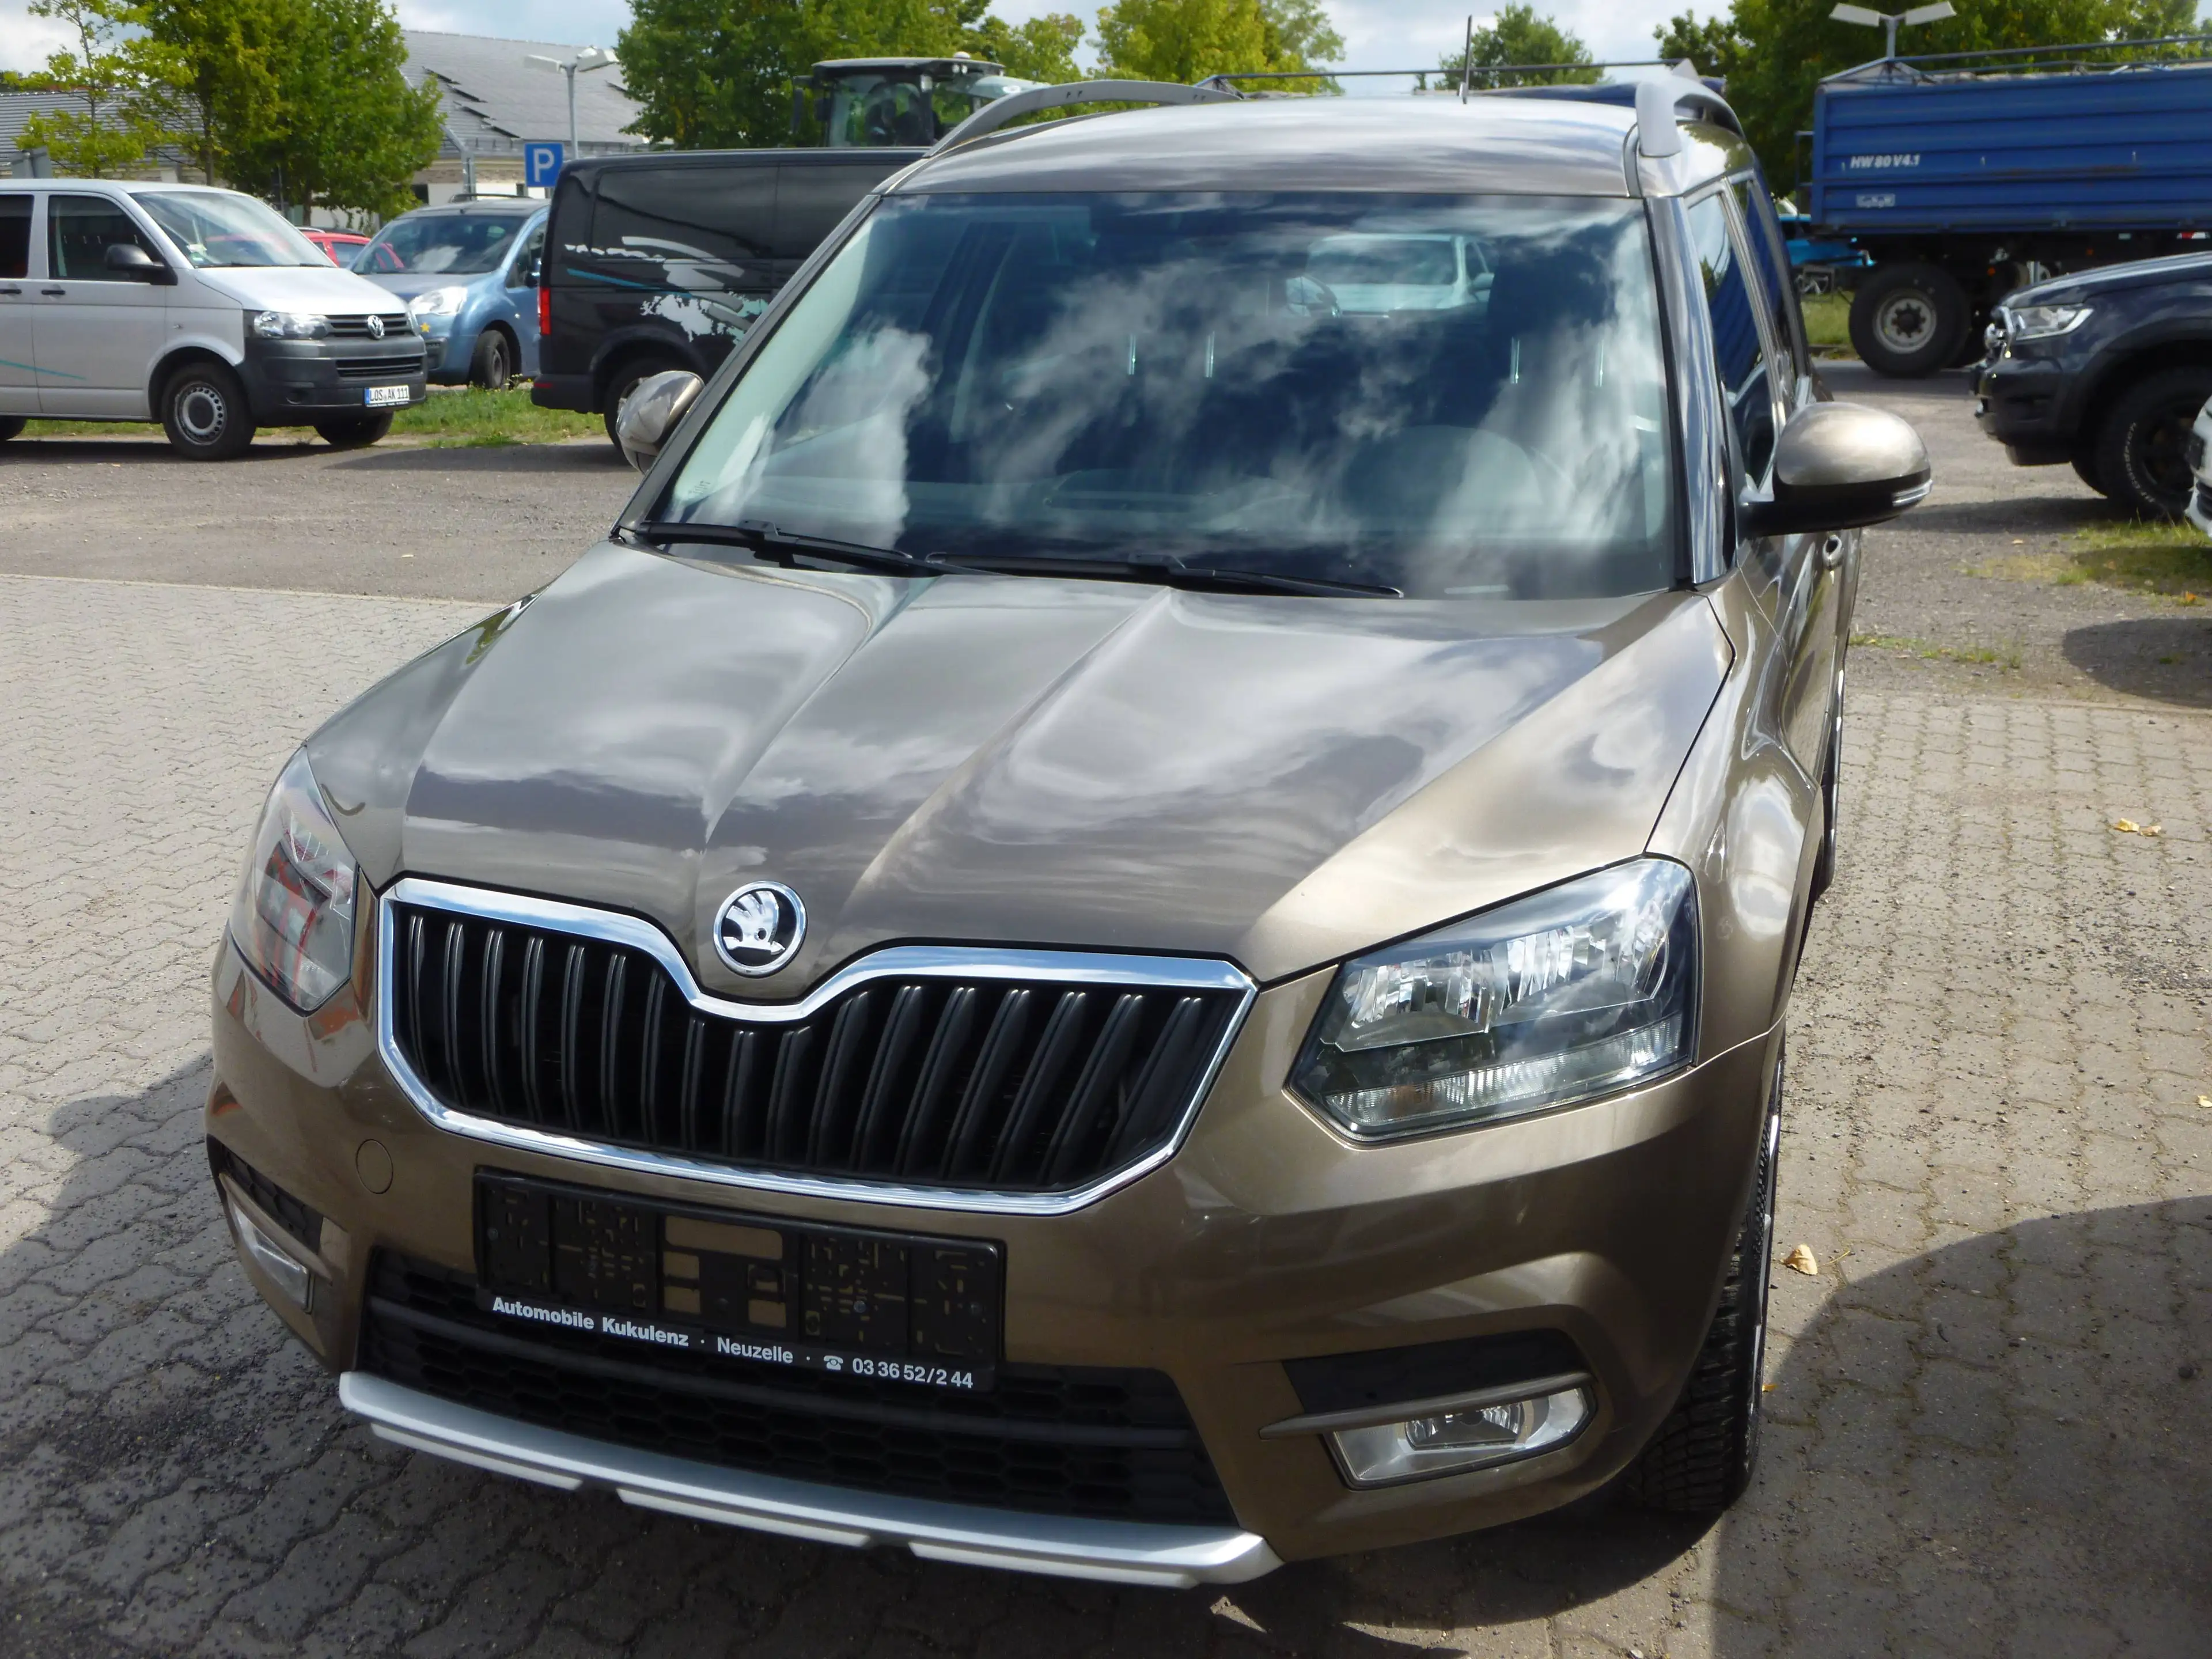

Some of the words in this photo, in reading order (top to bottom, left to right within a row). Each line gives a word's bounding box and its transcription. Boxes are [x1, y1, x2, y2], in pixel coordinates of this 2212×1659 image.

[533, 148, 554, 182] P
[1850, 156, 1874, 169] HW
[370, 389, 383, 402] LOS
[387, 389, 396, 400] AK
[397, 387, 408, 399] 111
[493, 1297, 594, 1330] Automobile
[603, 1317, 689, 1346] Kukulenz
[717, 1337, 793, 1363] Neuzelle
